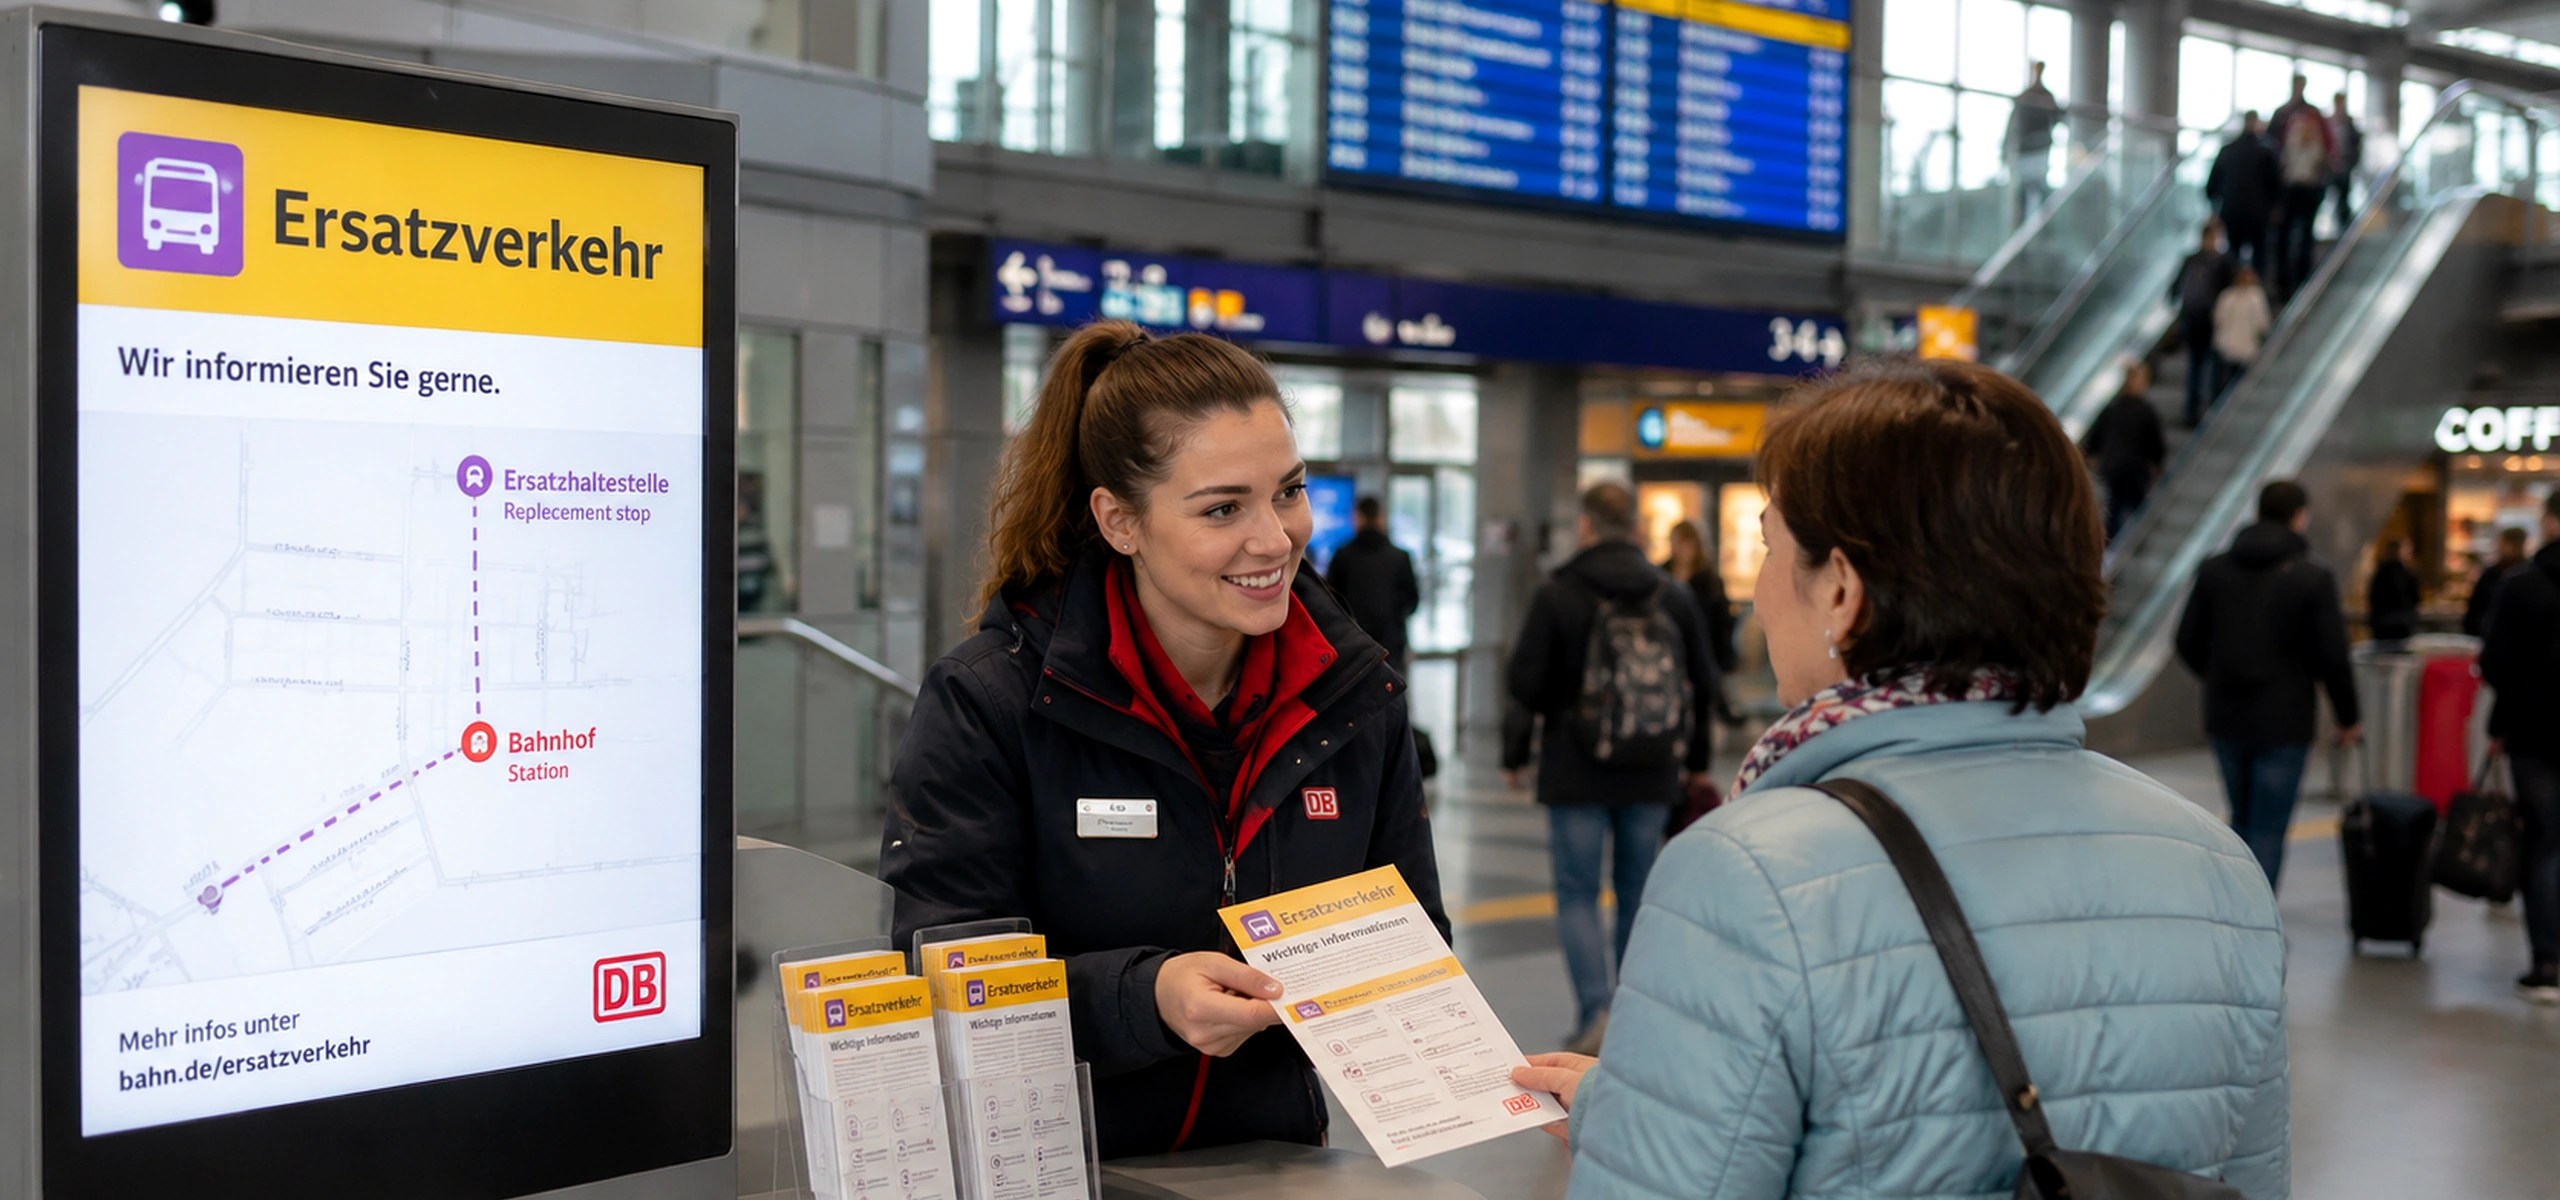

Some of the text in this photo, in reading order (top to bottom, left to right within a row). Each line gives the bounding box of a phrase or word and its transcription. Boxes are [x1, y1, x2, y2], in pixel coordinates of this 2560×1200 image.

[274, 188, 664, 280] Ersatzverkehr
[118, 346, 502, 397] Wir informieren Sie gerne.
[504, 468, 670, 494] Ersatzhaltestelle
[504, 502, 651, 526] Replecement stop
[508, 727, 597, 754] Bahnhof
[508, 762, 569, 783] Station
[1307, 792, 1335, 813] DB
[1279, 884, 1396, 926] Ersatzverkehr
[603, 963, 659, 1012] DB
[988, 976, 1060, 997] Ersatzverkehr
[847, 995, 922, 1017] Ersatzverkehr
[119, 1012, 301, 1053] Mehr infos unter
[119, 1036, 371, 1092] bahn.de/ersatzverkehr
